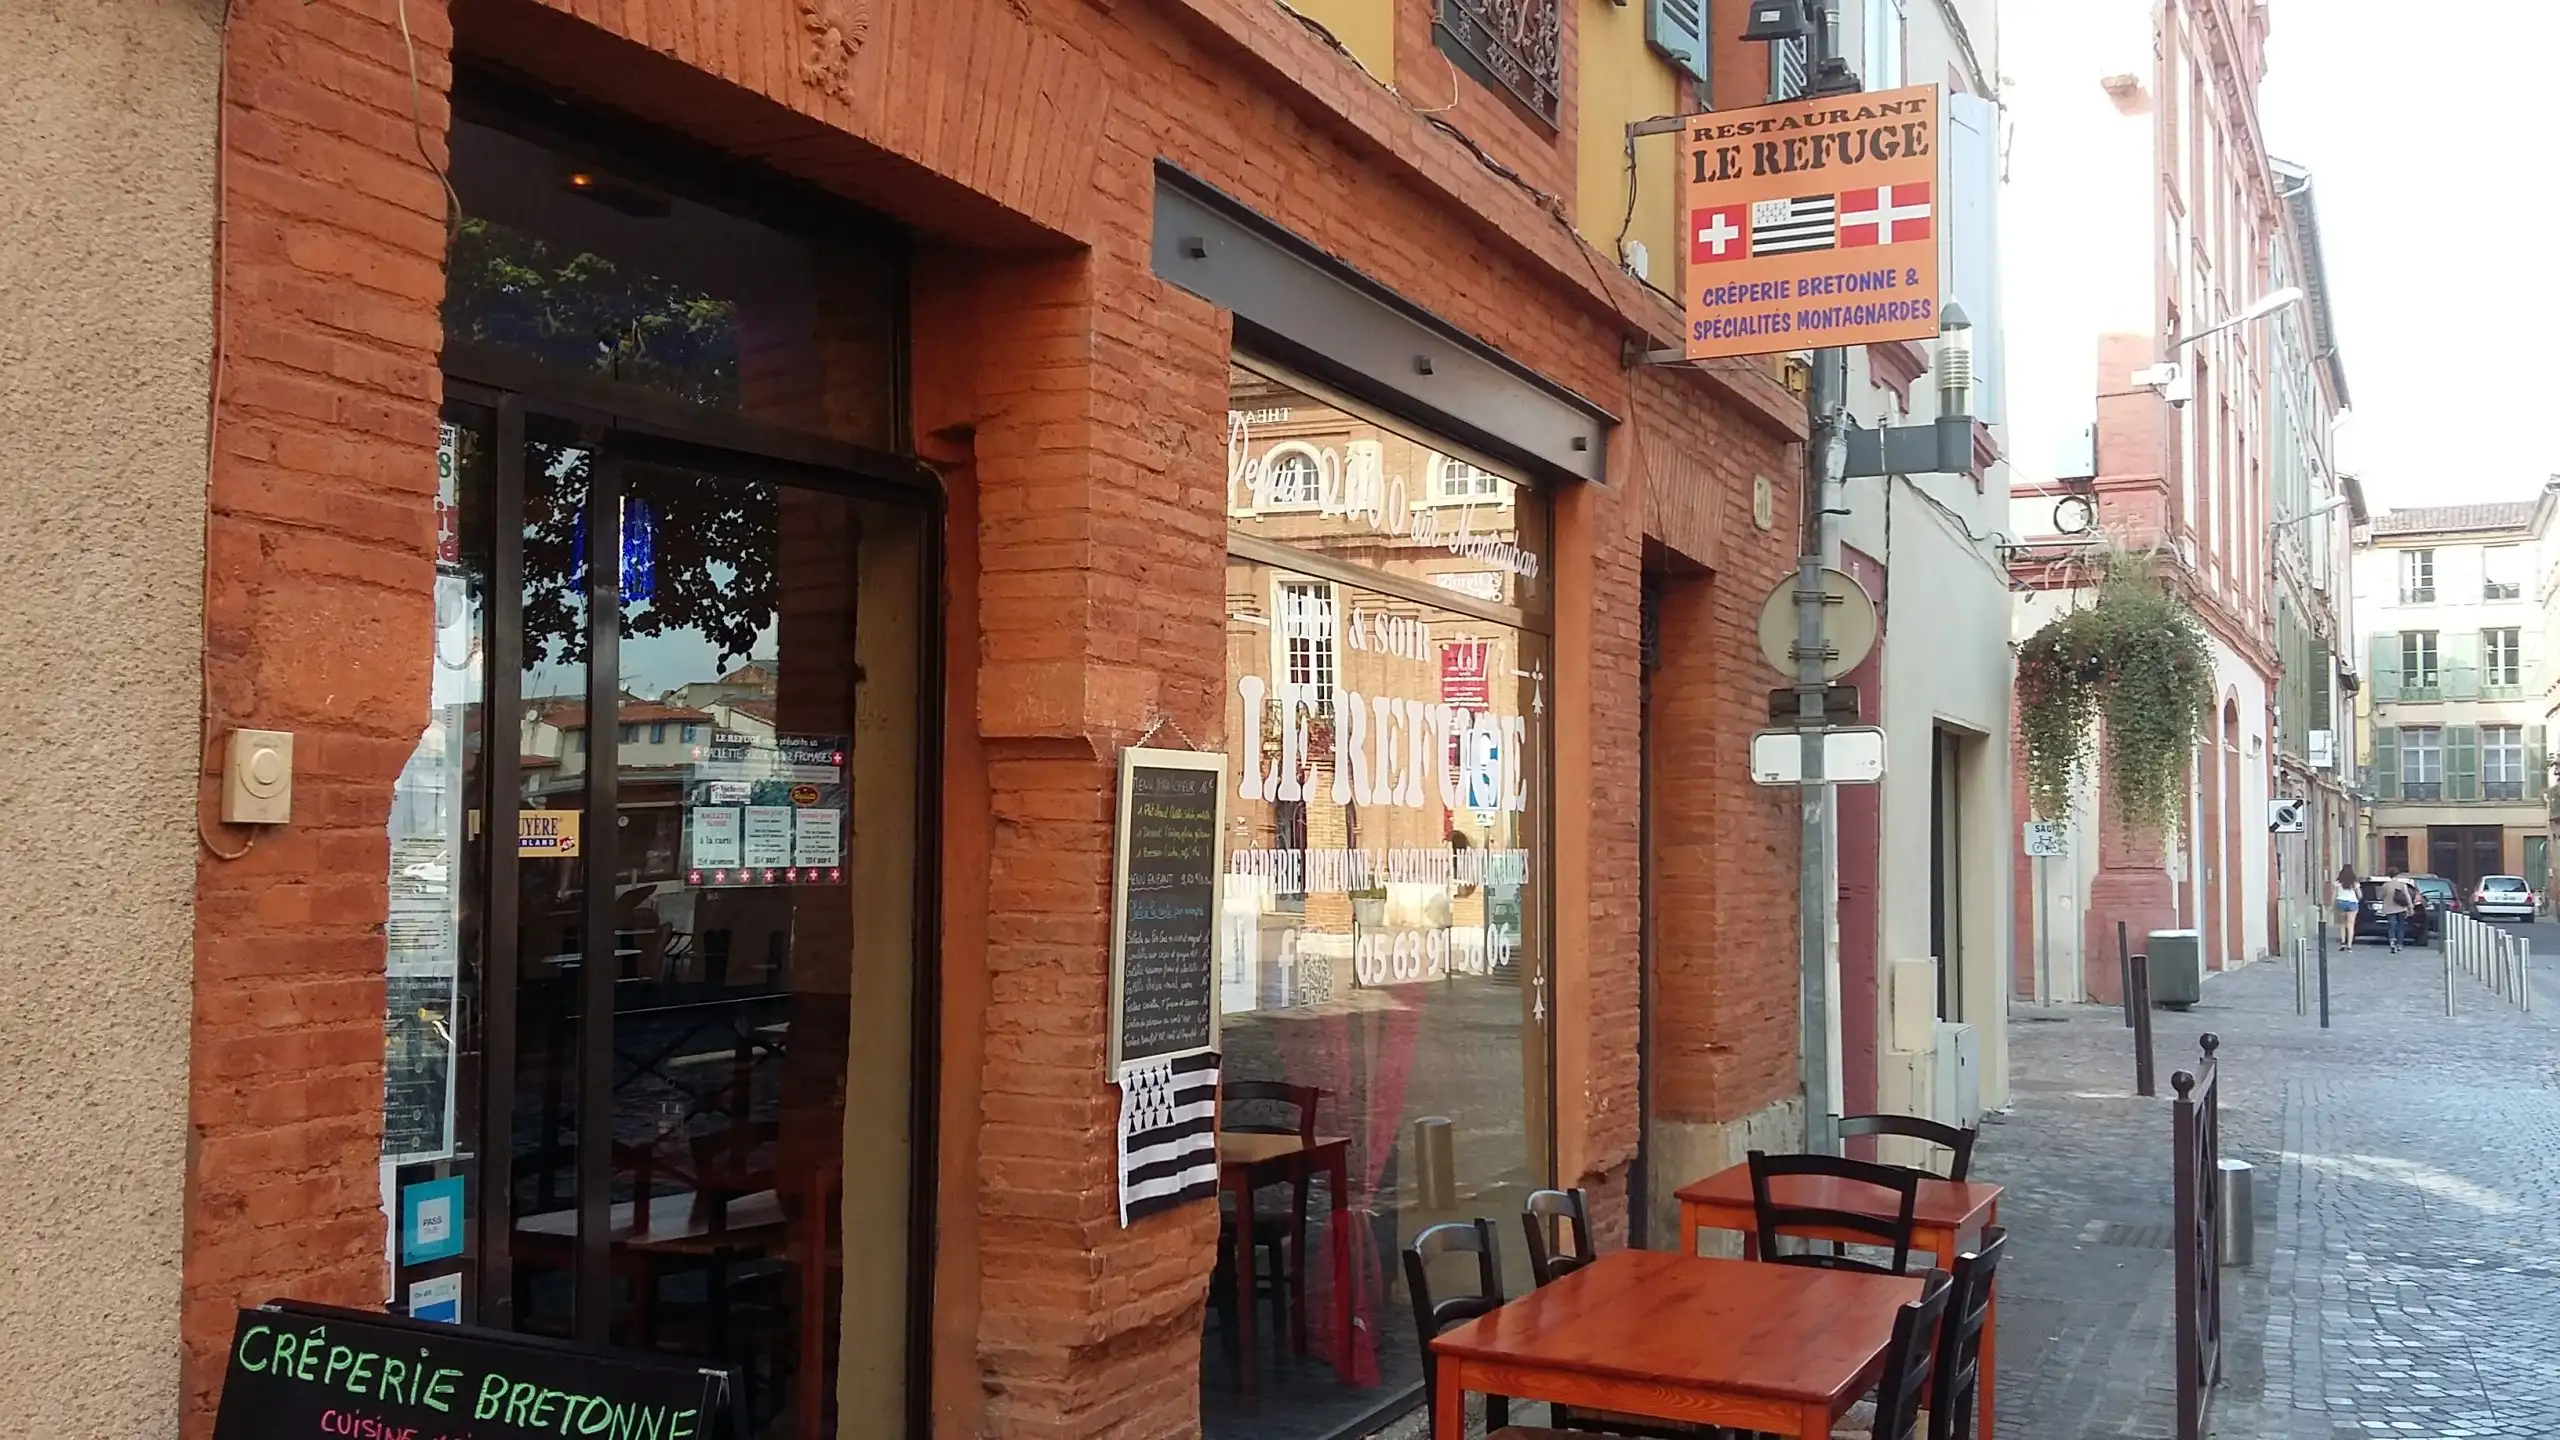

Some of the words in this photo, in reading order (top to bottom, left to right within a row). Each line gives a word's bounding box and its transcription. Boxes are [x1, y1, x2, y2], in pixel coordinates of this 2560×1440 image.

[1693, 99, 1927, 142] RESTAURANT
[1692, 145, 1742, 184] LE
[1753, 121, 1928, 175] REFUGE
[1702, 280, 1790, 307] CRÊPERIE
[1798, 269, 1896, 297] BRETONNE
[1905, 267, 1919, 286] &
[1693, 307, 1791, 341] SPÉCIALITÉS
[1797, 298, 1931, 331] MONTAGNARDES
[1411, 506, 1441, 548] sur
[1448, 498, 1540, 579] Montauban
[1349, 607, 1367, 651] &
[1374, 612, 1431, 662] SOIR
[716, 734, 727, 743] LE
[728, 735, 761, 743] REFUGE
[794, 752, 833, 763] FROMAGES
[1238, 675, 1317, 802] LE
[1331, 688, 1527, 812] REFUGE
[1358, 934, 1387, 985] 05
[1393, 931, 1420, 980] 63
[1427, 928, 1450, 976] 91
[1487, 923, 1510, 967] 06
[239, 1326, 464, 1412] CRÊPERIE
[475, 1374, 697, 1440] BRETONNE
